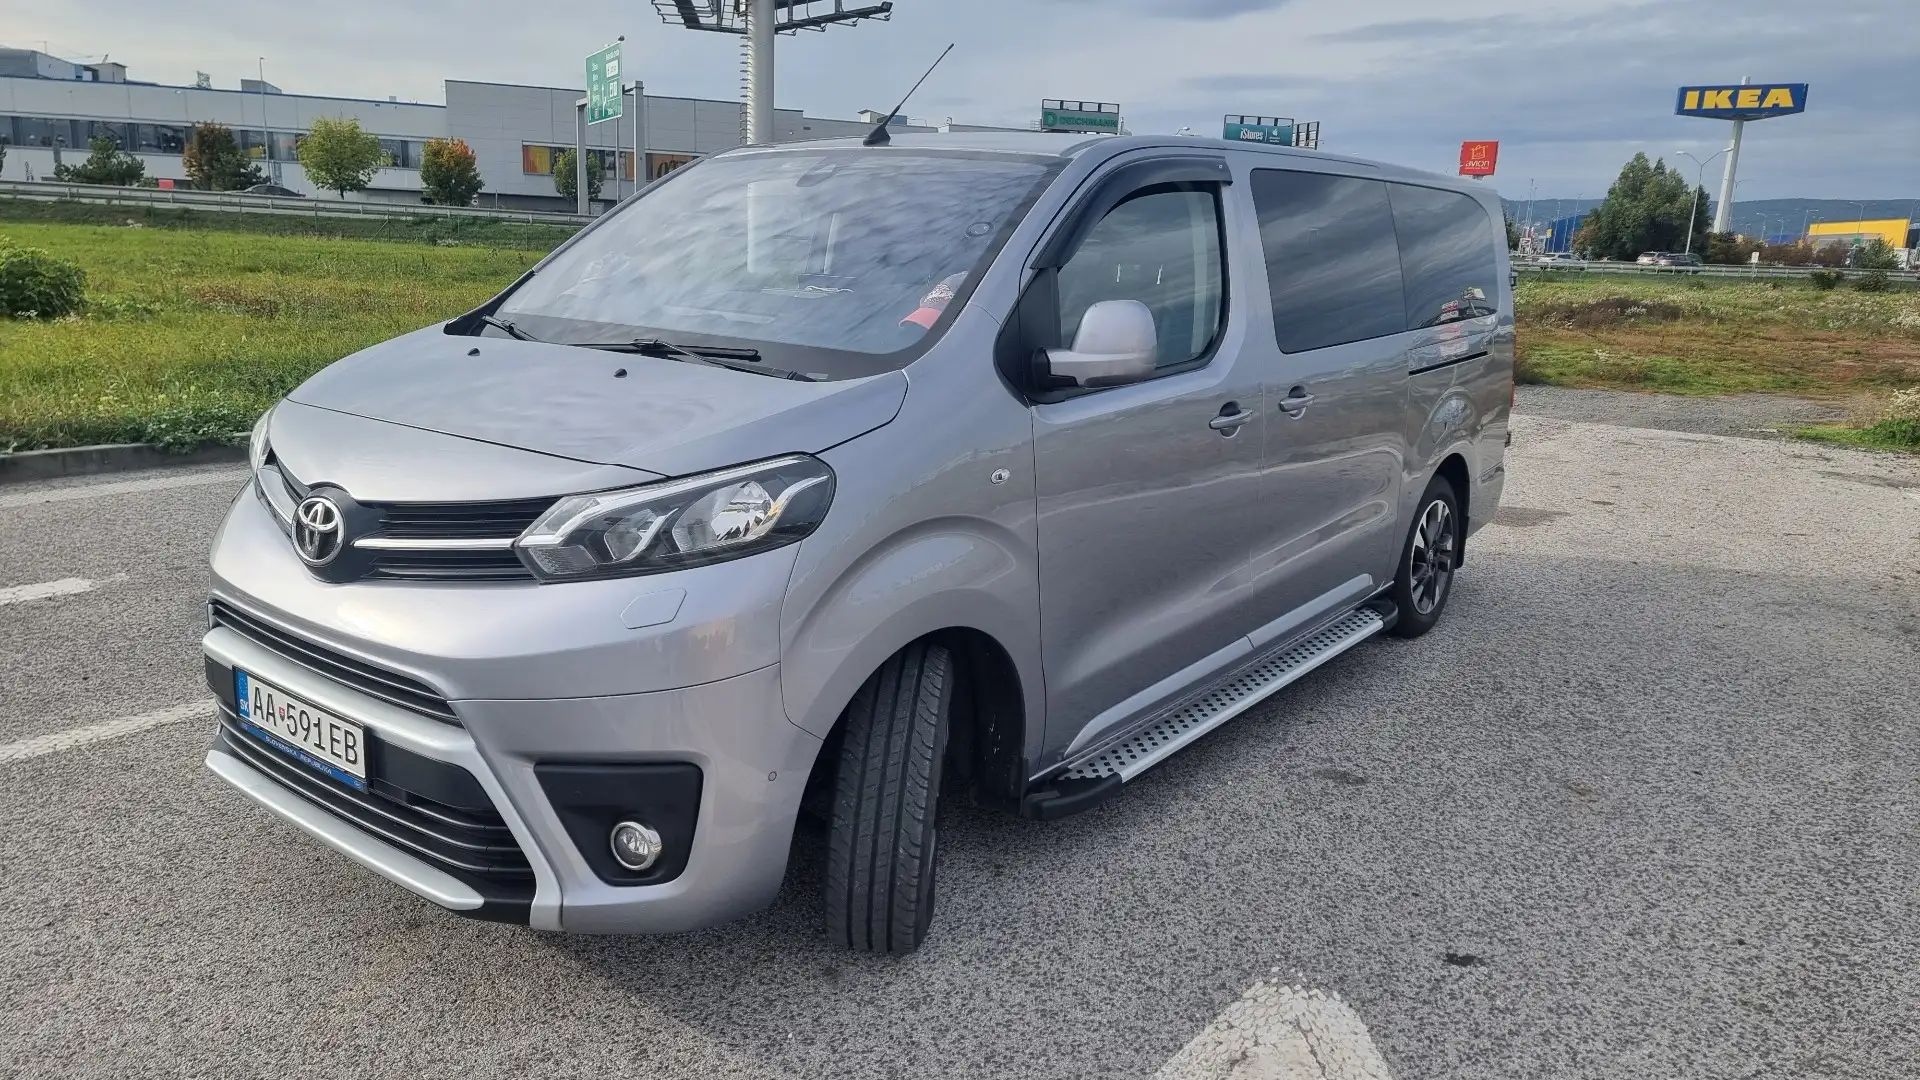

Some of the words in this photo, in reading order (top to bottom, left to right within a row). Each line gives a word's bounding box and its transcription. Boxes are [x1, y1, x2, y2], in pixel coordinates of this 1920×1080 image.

[1683, 88, 1794, 110] IKEA
[1240, 128, 1264, 140] iStores
[240, 698, 249, 713] SK
